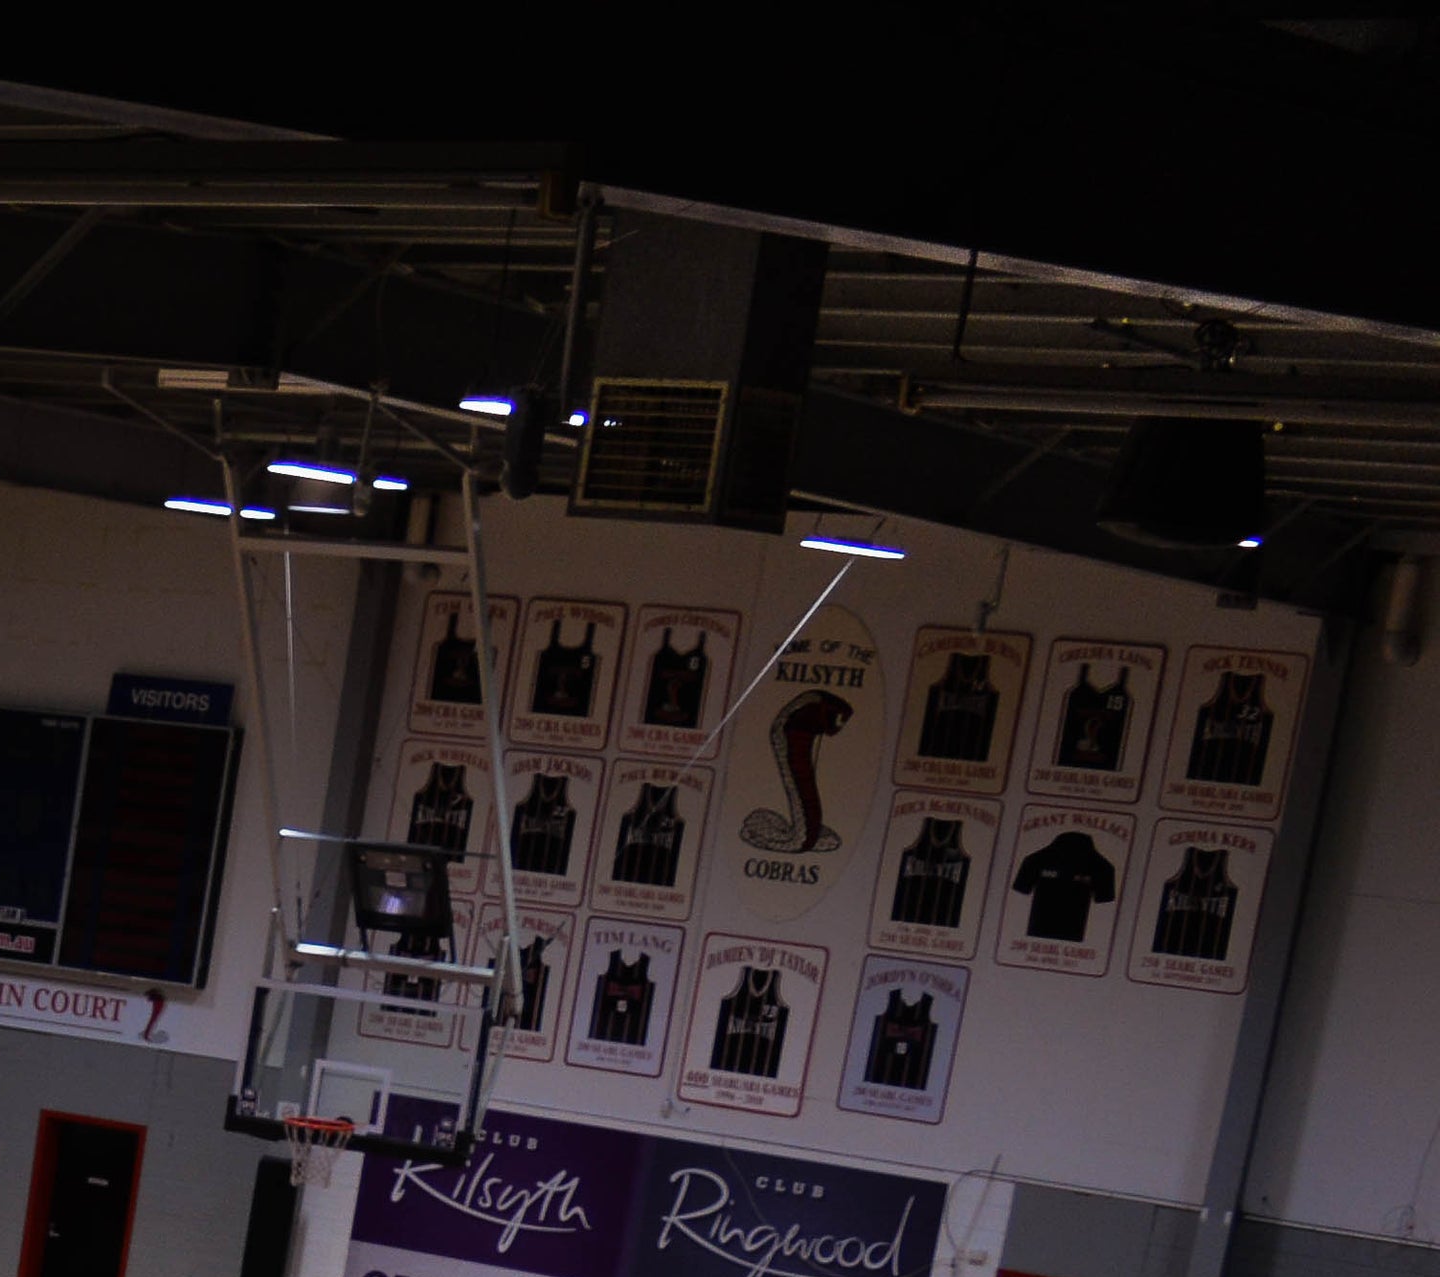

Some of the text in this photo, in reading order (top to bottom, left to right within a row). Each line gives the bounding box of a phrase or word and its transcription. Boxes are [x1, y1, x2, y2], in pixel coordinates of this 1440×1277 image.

[820, 639, 840, 655] OF
[848, 642, 876, 666] THE
[1059, 646, 1114, 664] CHELSEA
[774, 661, 867, 689] KILSYTH
[130, 687, 211, 713] VISITORS
[1022, 812, 1130, 841] GRANT WALLACE
[1169, 830, 1257, 853] GEMMA KERR
[743, 857, 821, 885] COBRAS
[594, 930, 674, 953] TIM LANG
[779, 950, 819, 984] TAYLOR
[32, 987, 129, 1023] COURT
[754, 1174, 826, 1200] CLUB
[390, 1152, 593, 1254] Kilsyth
